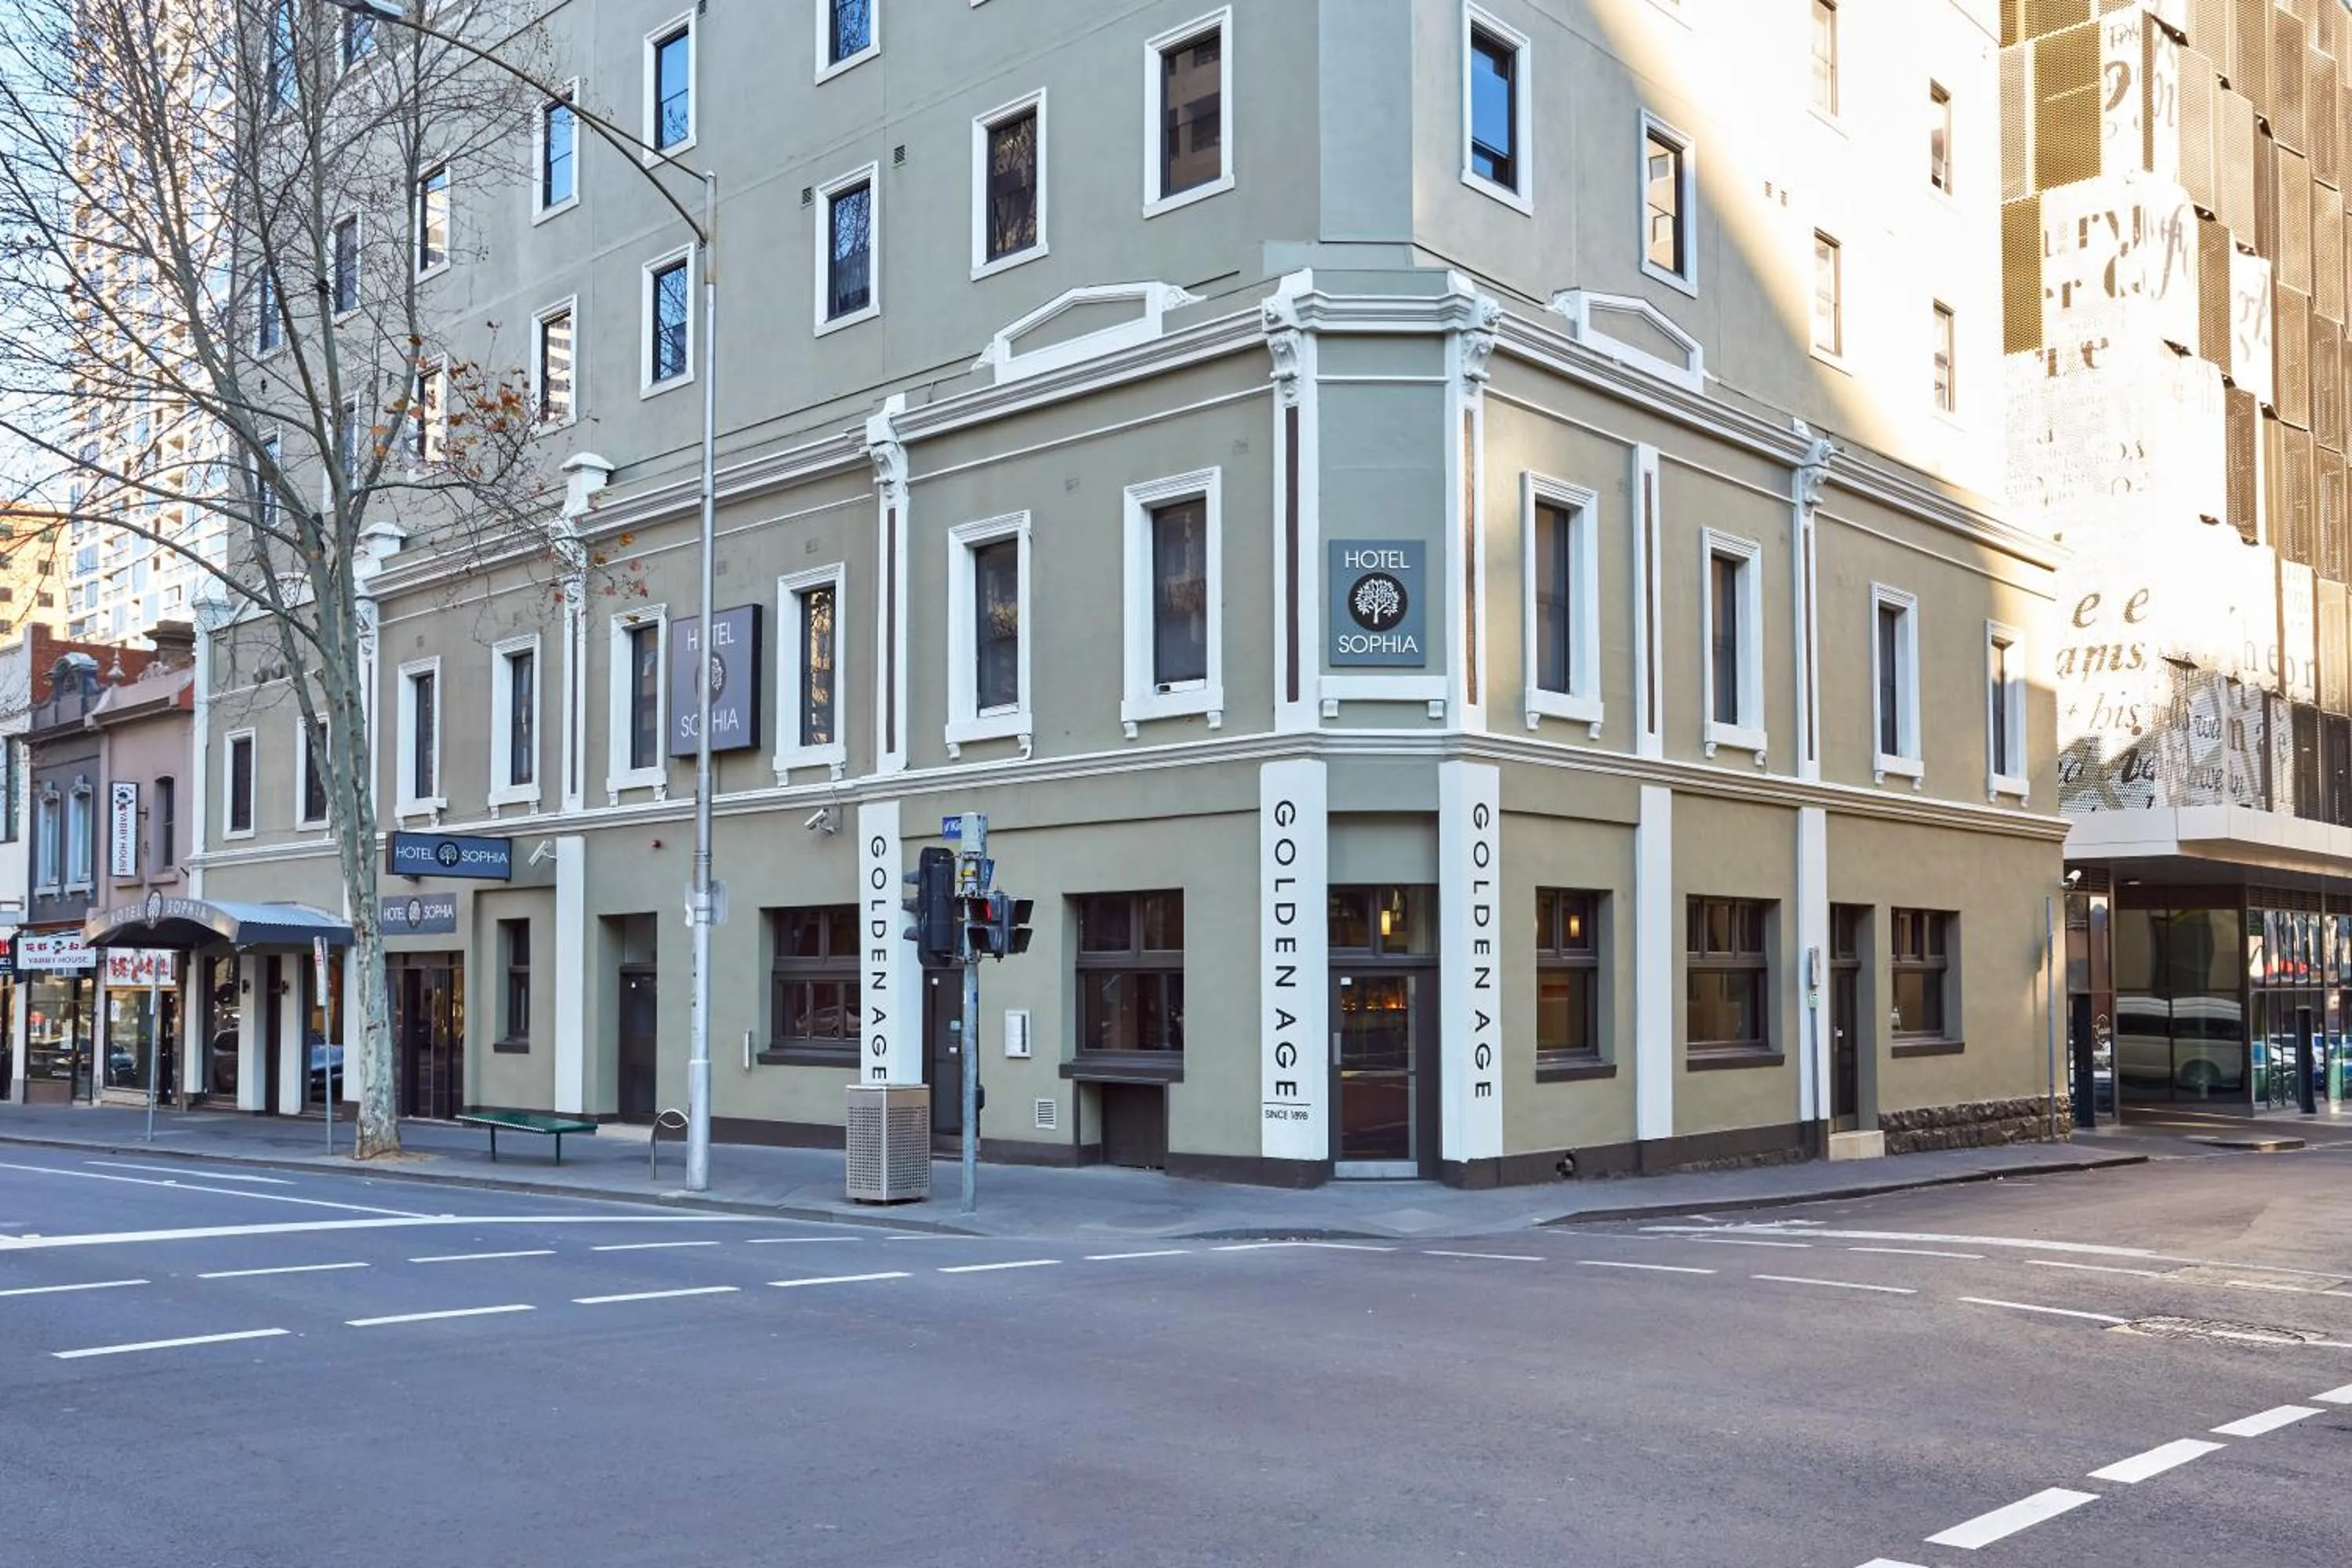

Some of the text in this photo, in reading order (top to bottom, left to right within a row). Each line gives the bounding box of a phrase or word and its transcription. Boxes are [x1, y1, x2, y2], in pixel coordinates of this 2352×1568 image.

[1345, 550, 1410, 568] HOTEL
[688, 622, 735, 652] HTEL
[1338, 634, 1418, 653] SOPHIA
[681, 708, 739, 739] SOHIA
[118, 843, 128, 874] HOUSE
[396, 846, 508, 864] HOTEL SOPHIA
[111, 901, 207, 924] HOTEL SOPHIA
[383, 904, 454, 921] HOTEL SOPHIA
[871, 835, 887, 1080] GOLDEN AGE
[1275, 800, 1298, 1097] GOLDEN AGE
[1473, 802, 1492, 1098] GOLDEN AGE
[1265, 1110, 1288, 1120] SINCE
